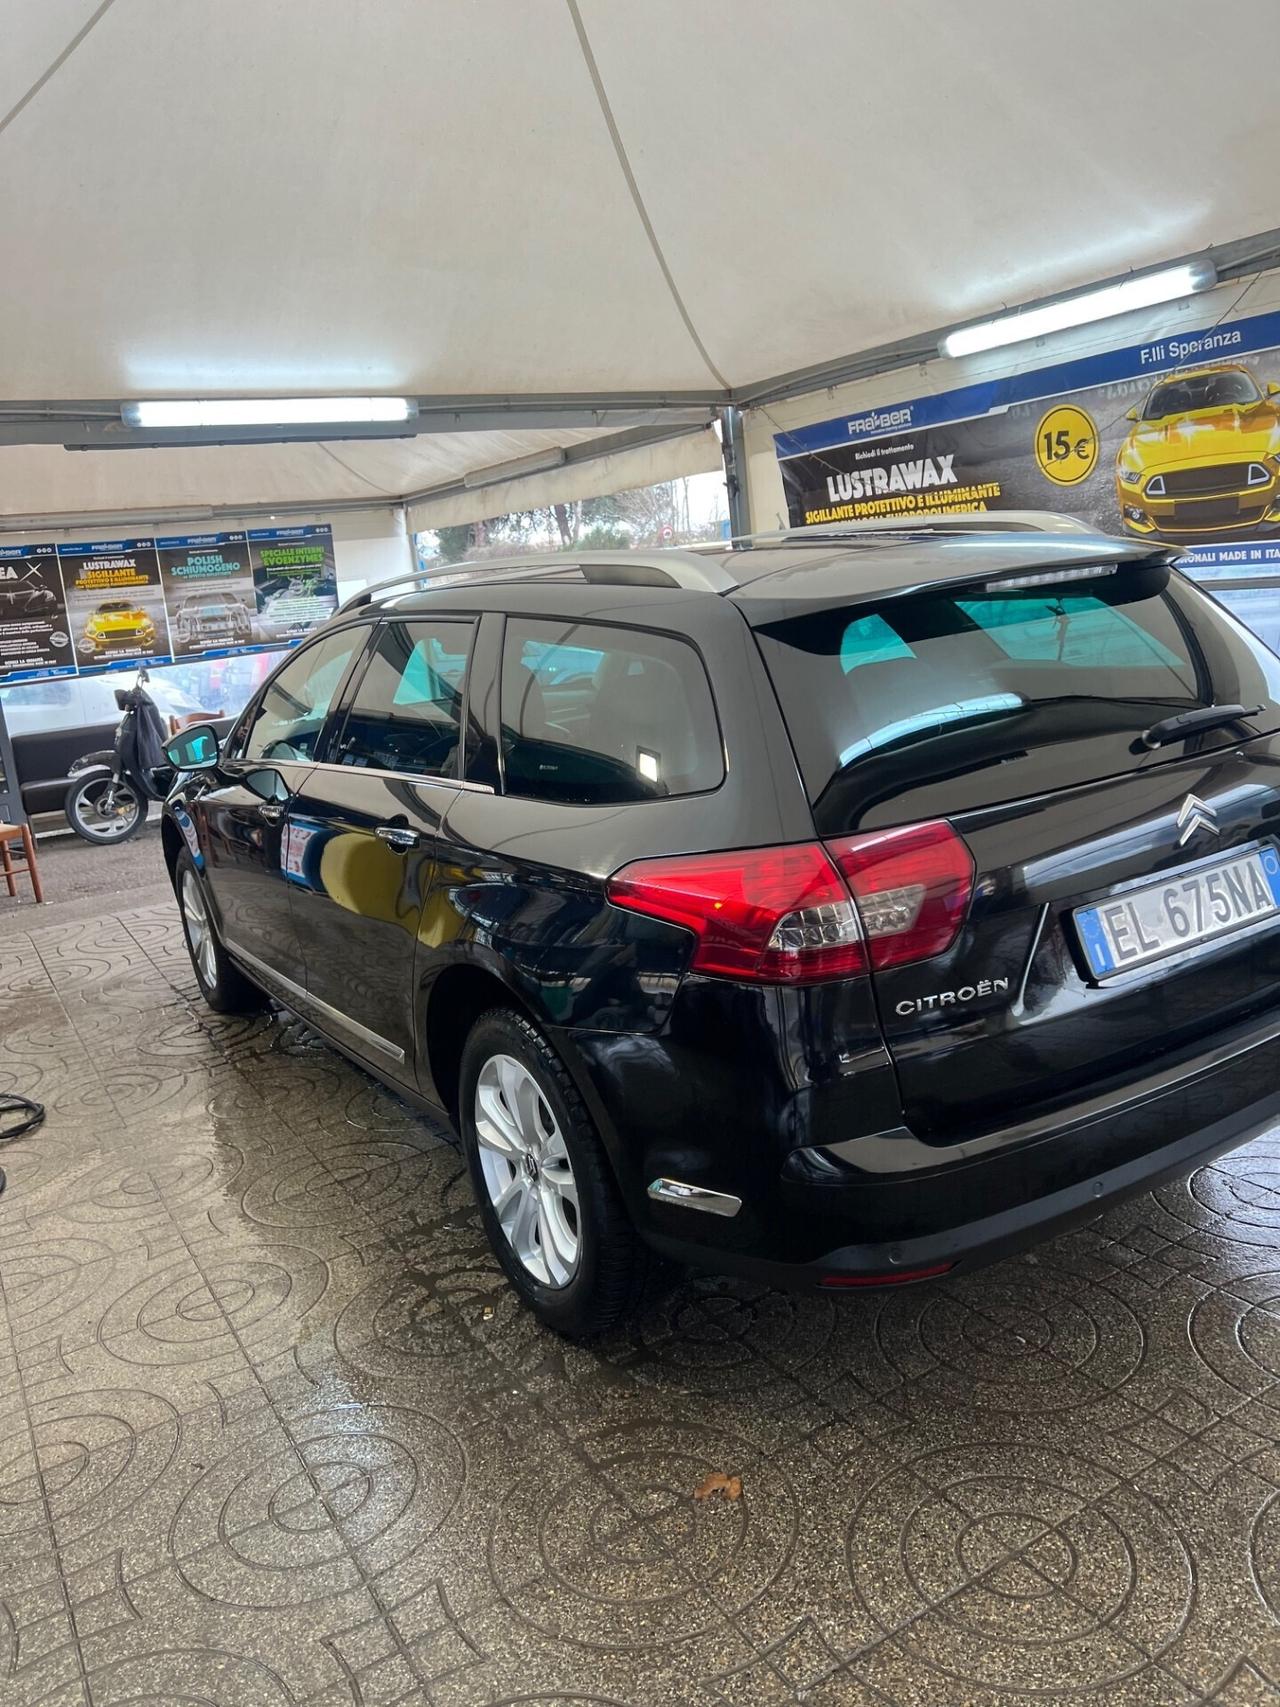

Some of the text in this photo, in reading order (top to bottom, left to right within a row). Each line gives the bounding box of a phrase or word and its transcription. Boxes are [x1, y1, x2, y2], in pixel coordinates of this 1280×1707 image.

[1169, 331, 1241, 360] Speranza
[1044, 430, 1090, 461] 15€
[826, 454, 958, 503] LUSTRAWAX
[805, 504, 854, 525] SIGILLANTE
[855, 495, 915, 516] PROTETTIVO
[917, 495, 924, 506] E
[926, 482, 1001, 506] ILLUMINANTE
[83, 559, 136, 570] LUSTRAWAX
[171, 562, 240, 576] SCHIUMOGENO
[187, 554, 223, 566] POLISH
[1219, 550, 1247, 561] MADE
[1250, 549, 1261, 559] IN
[87, 567, 136, 579] SIGILLANTE
[1103, 861, 1271, 961] EL 675NA
[895, 977, 1009, 1016] CITROËN
